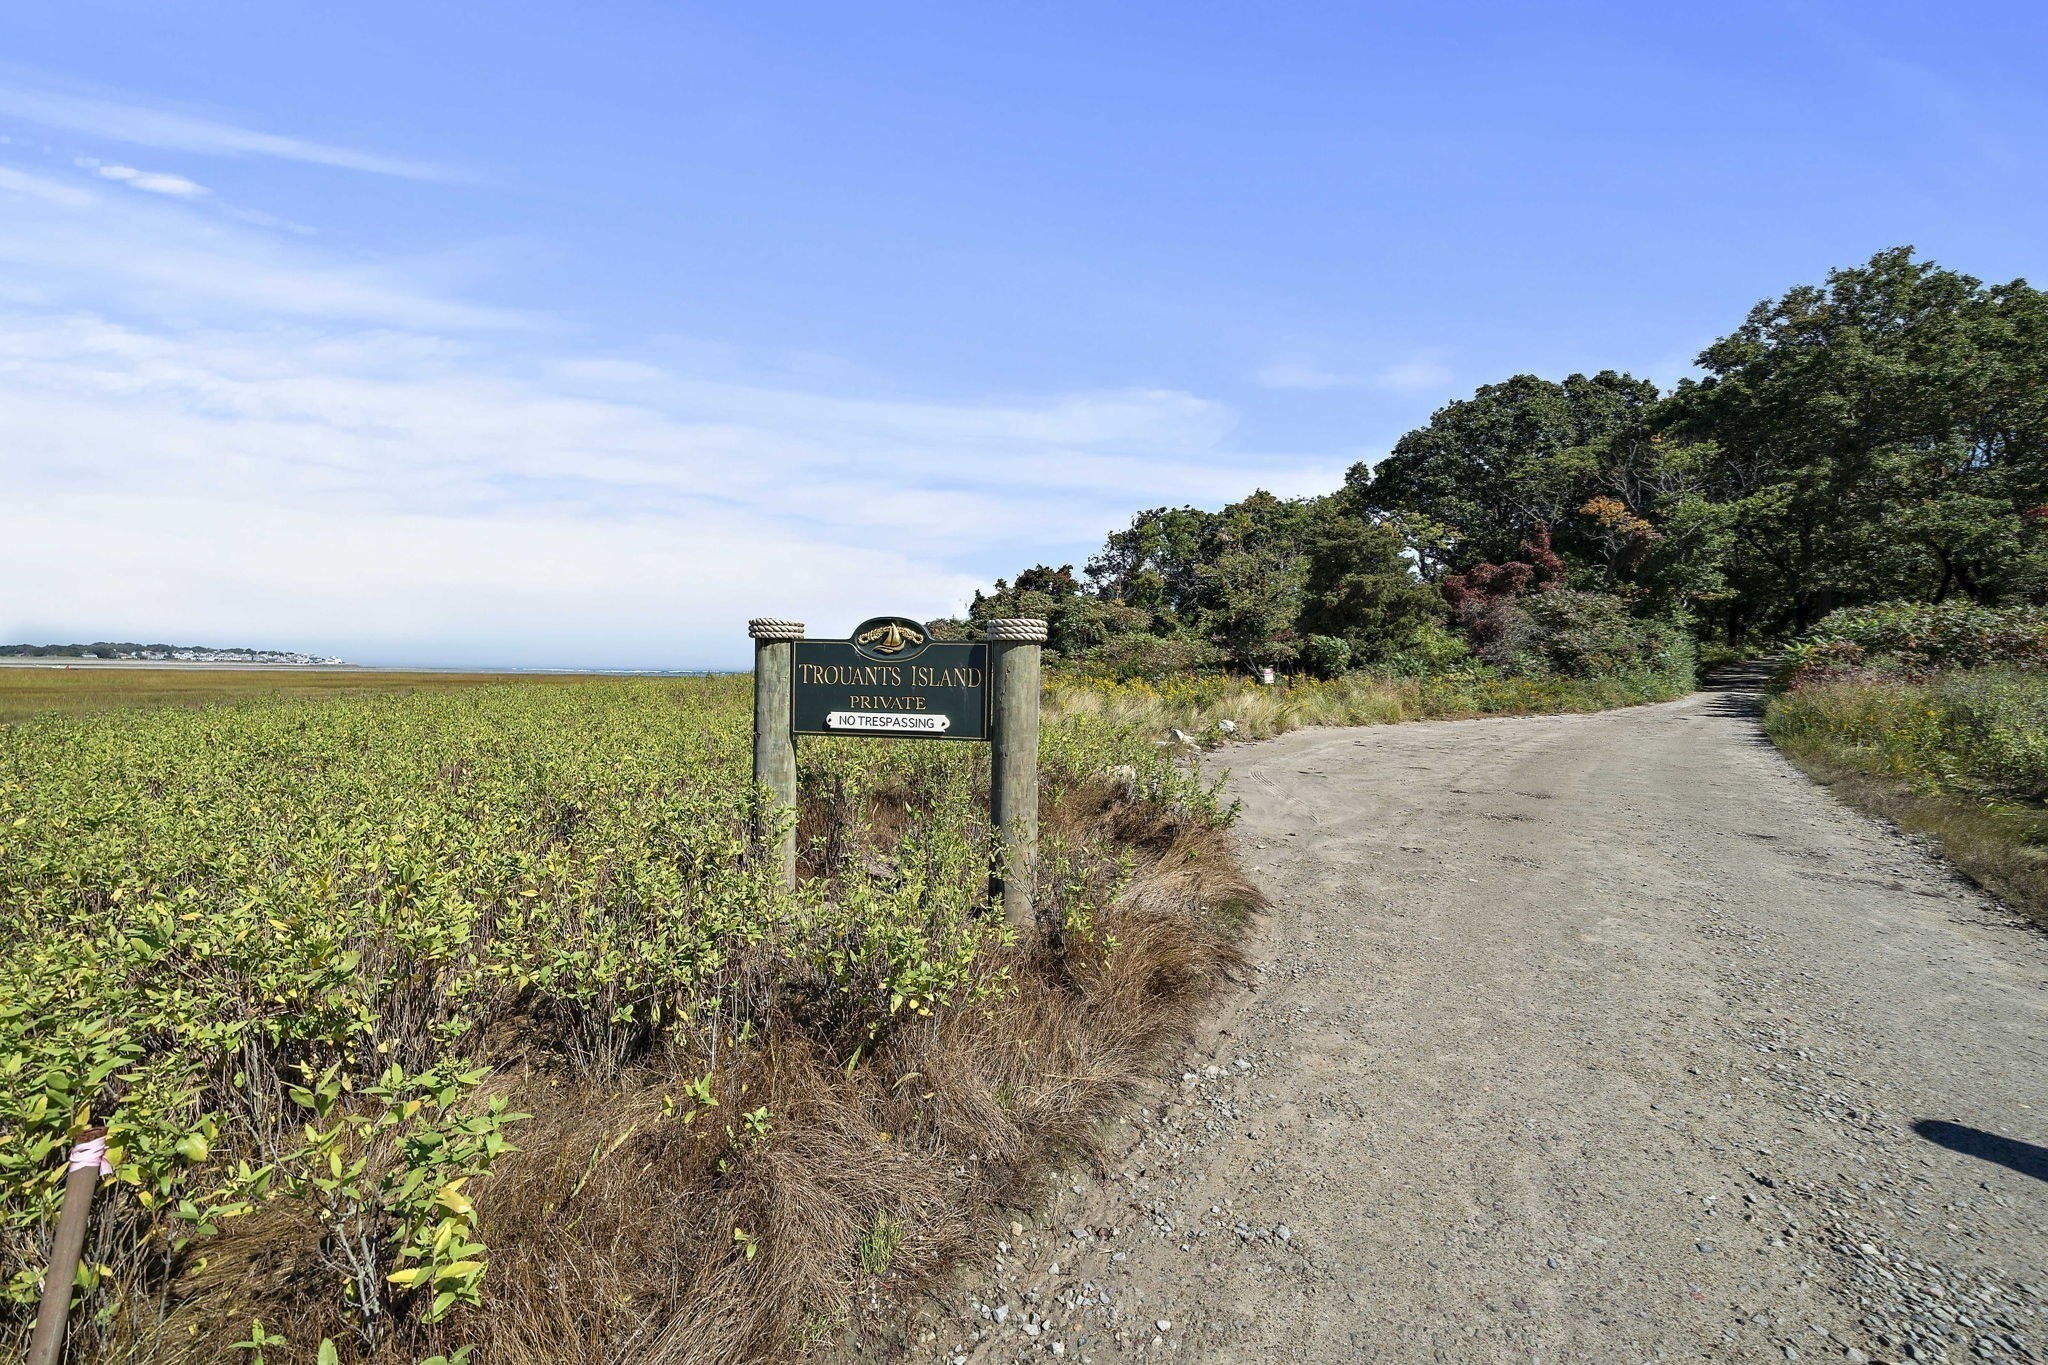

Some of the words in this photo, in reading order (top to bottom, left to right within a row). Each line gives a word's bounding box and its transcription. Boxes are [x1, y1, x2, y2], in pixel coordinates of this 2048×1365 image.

[799, 664, 901, 687] TROUANTS
[911, 665, 982, 688] ISLAND
[850, 695, 927, 710] PRIVATE
[839, 715, 856, 726] NO
[858, 716, 935, 729] TRESPASSING
